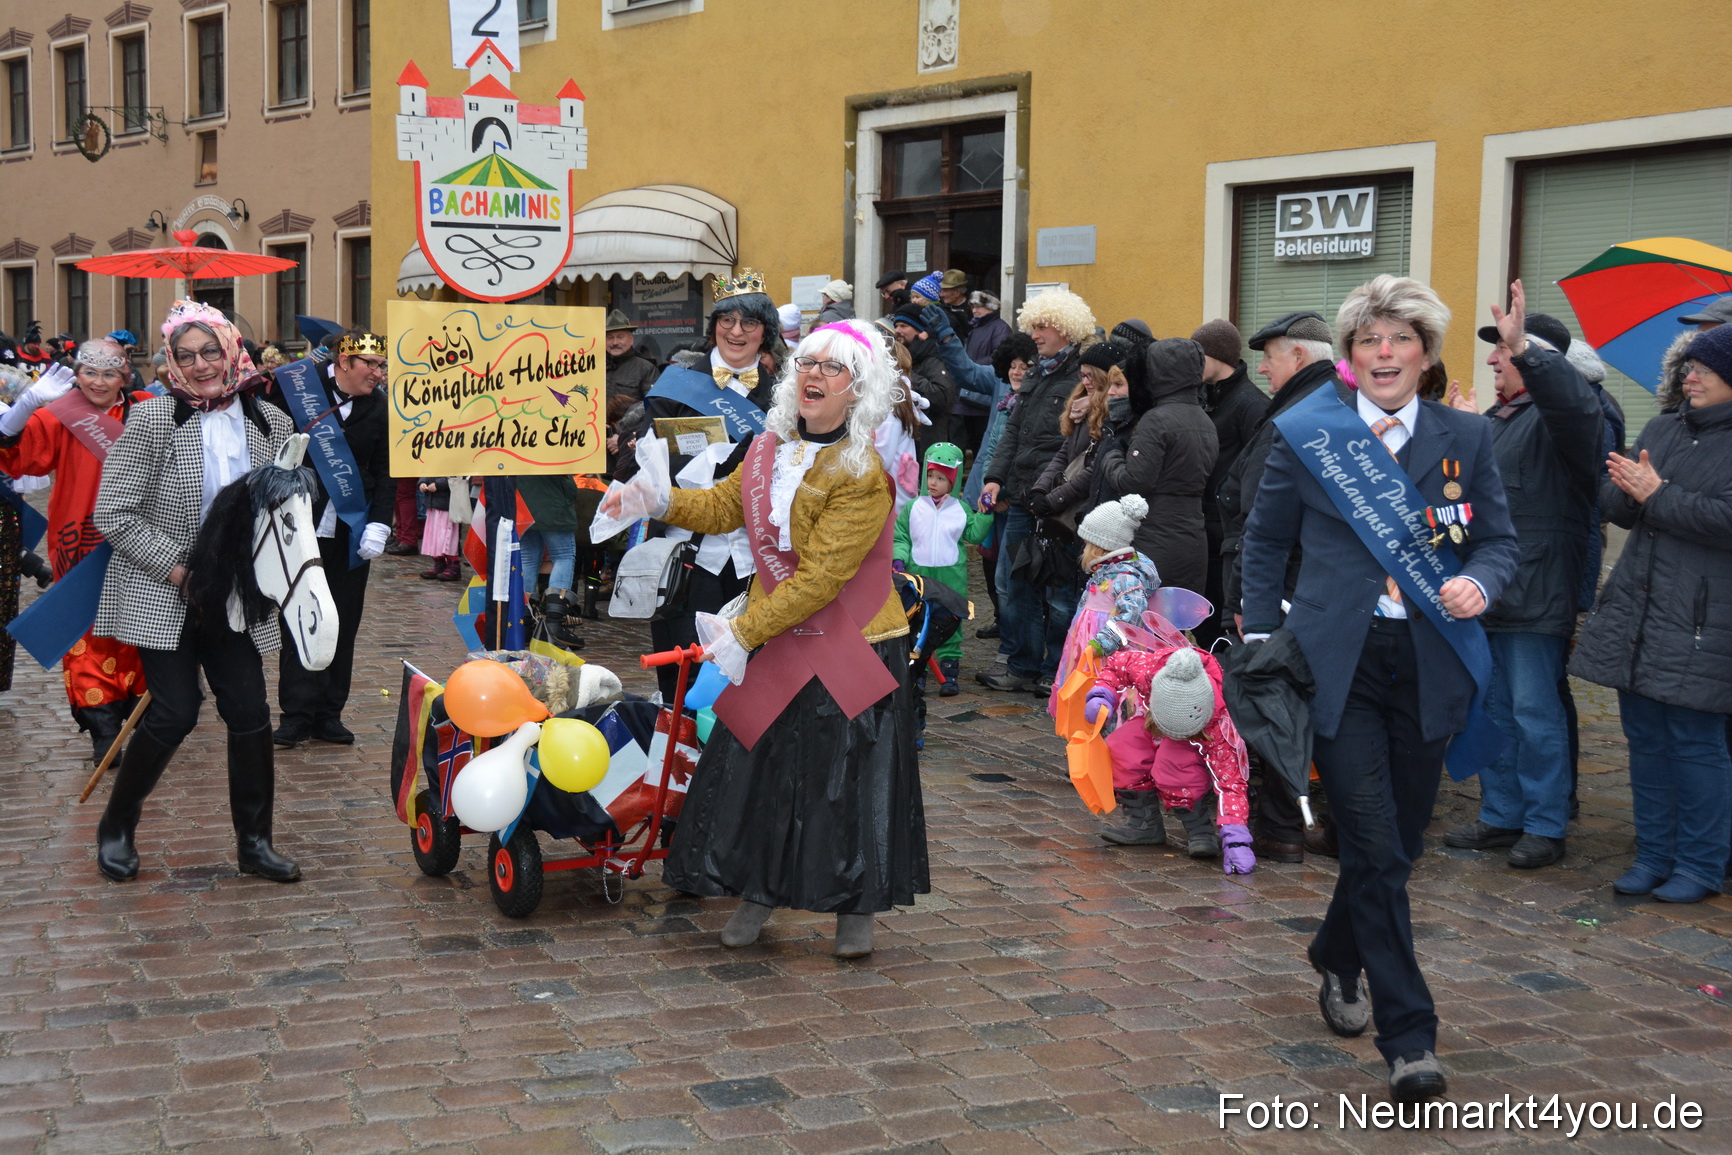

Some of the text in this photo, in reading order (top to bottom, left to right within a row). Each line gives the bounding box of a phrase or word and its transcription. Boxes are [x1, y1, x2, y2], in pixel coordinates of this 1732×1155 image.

[471, 0, 501, 37] 2
[429, 188, 560, 220] BACHAMINIS
[1279, 192, 1370, 232] BW
[1274, 237, 1372, 257] Bekleidung
[645, 327, 694, 335] SPEICHERMEDIEN
[403, 349, 596, 410] Königliche Hoheiten
[284, 364, 307, 391] Prinz
[314, 424, 335, 458] Thurn
[333, 463, 352, 497] Taxis
[709, 398, 752, 434] König
[412, 416, 586, 459] geben sich die Ehre
[752, 455, 762, 479] von
[750, 474, 764, 527] Thurn
[1347, 438, 1444, 574] Ernst Pinkelprinz
[755, 527, 764, 539] &
[1302, 428, 1394, 538] Prügelaugust
[1398, 549, 1456, 622] Hannover
[758, 534, 790, 582] Taxis
